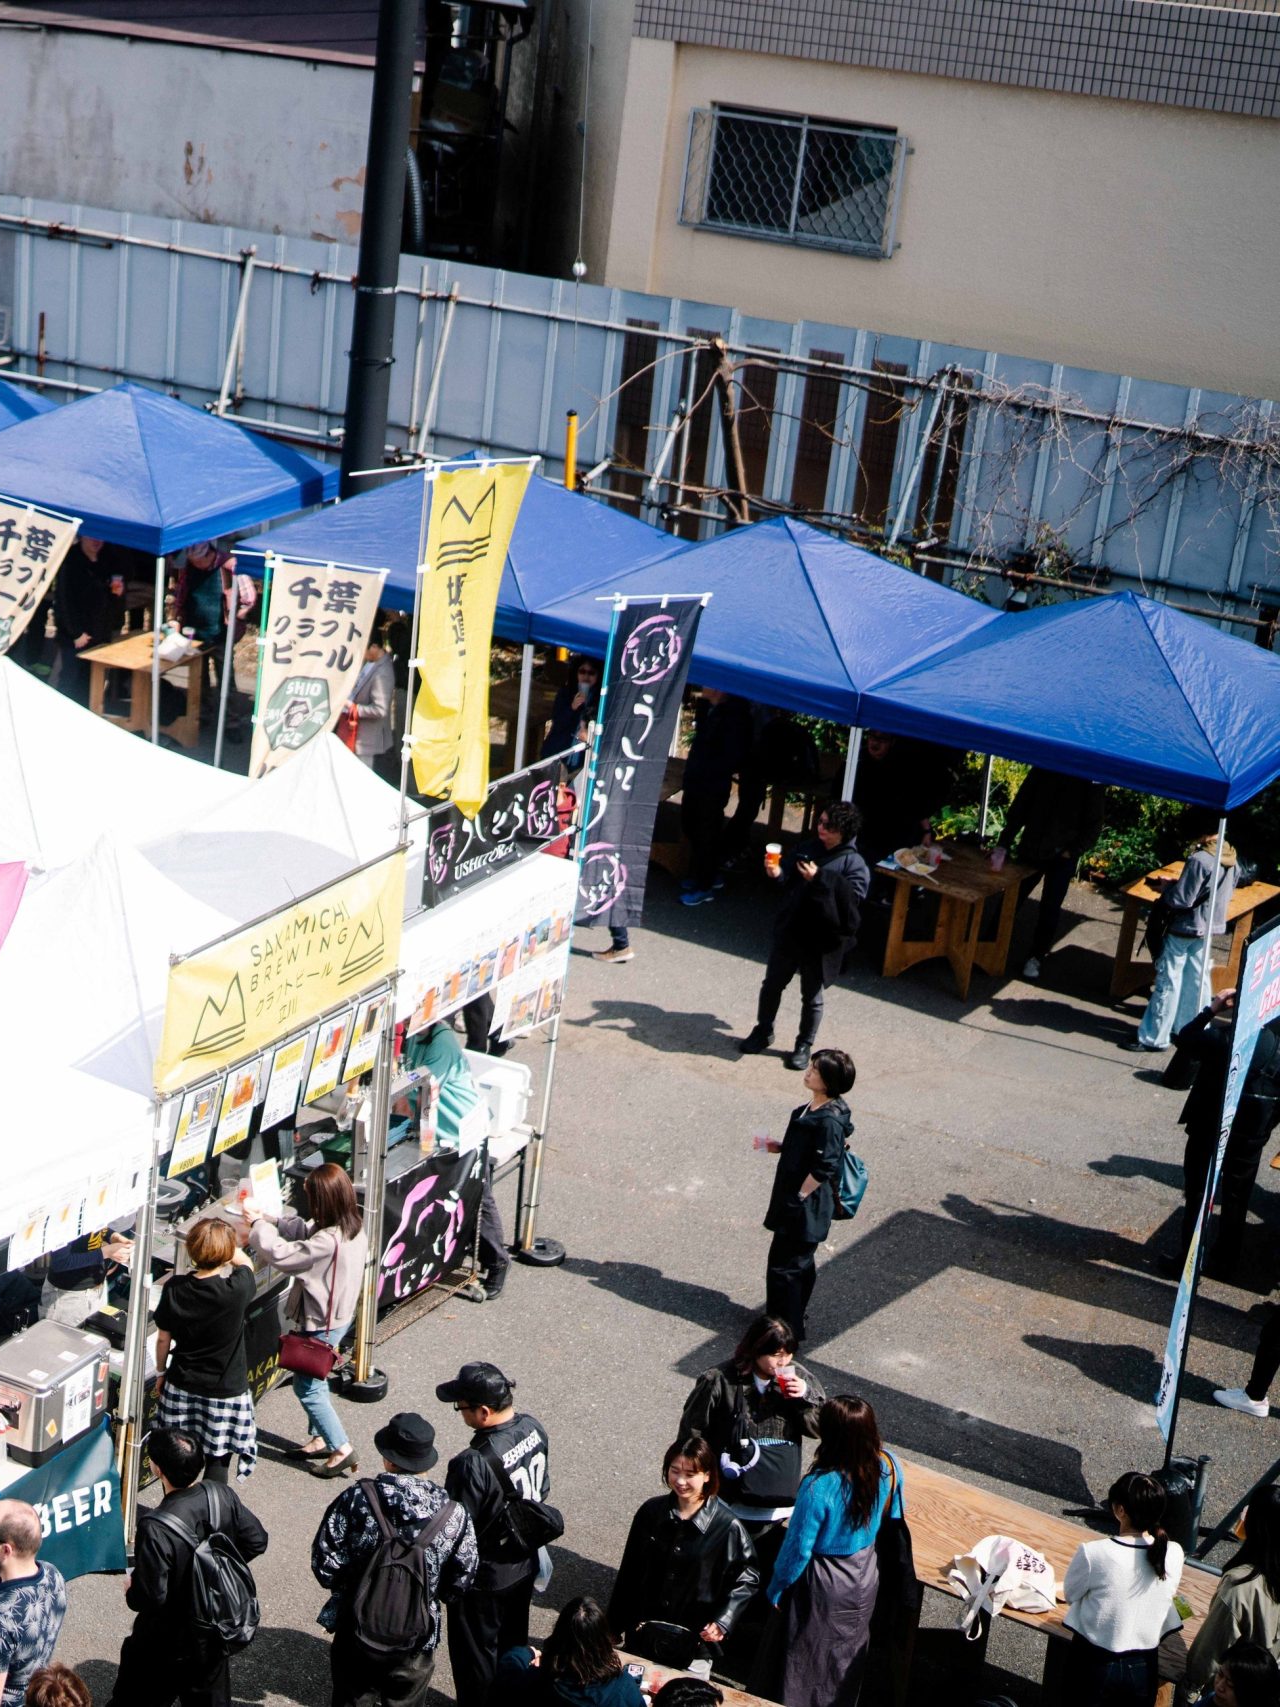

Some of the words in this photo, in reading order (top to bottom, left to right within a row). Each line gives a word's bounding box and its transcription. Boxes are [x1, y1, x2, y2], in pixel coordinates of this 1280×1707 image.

[288, 577, 362, 615] 千葉
[274, 615, 362, 643] クラフト
[272, 638, 354, 672] ビール
[285, 681, 322, 697] SHIO
[453, 842, 516, 881] USHITORA
[250, 900, 351, 967] SAKAMICHI
[250, 927, 348, 993] BREWING
[256, 961, 334, 1018] クラフトビール
[36, 1479, 112, 1540] BEER
